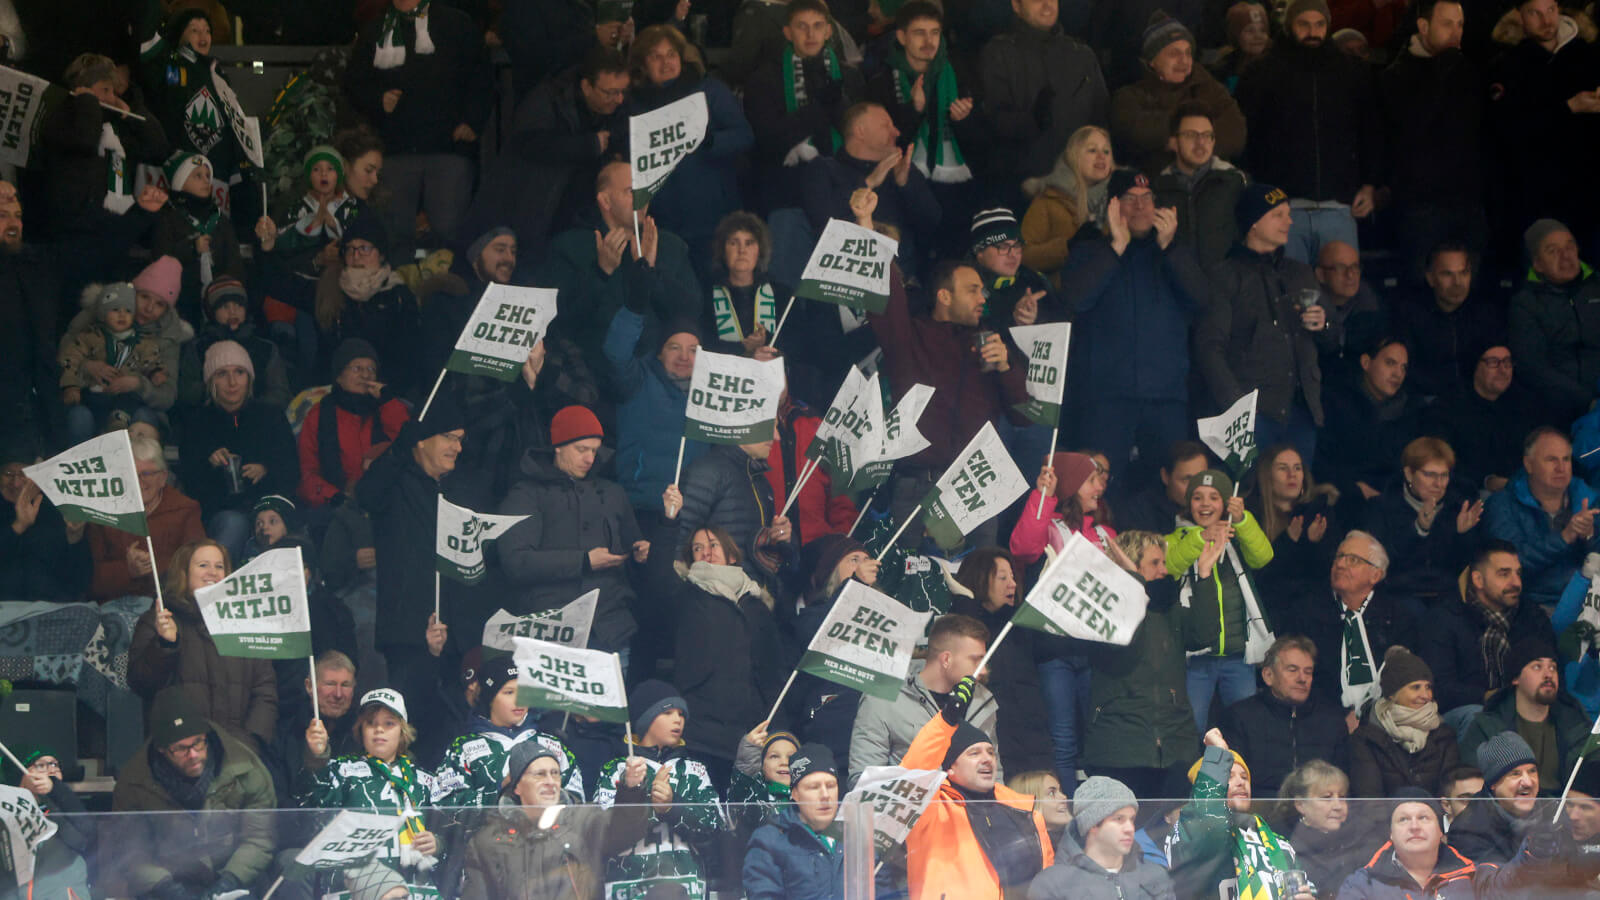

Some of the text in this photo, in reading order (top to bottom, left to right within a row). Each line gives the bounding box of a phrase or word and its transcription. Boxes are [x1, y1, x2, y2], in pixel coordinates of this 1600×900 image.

[649, 121, 686, 149] EHC
[840, 238, 878, 257] EHC
[819, 253, 885, 279] OLTEN
[494, 303, 536, 325] EHC
[473, 322, 539, 348] OLTEN
[708, 372, 755, 394] EHC
[691, 388, 767, 413] OLTEN
[967, 449, 996, 488] EHC
[951, 468, 986, 513] TEN
[1076, 571, 1119, 611] EHC
[851, 606, 897, 633] EHC
[1052, 583, 1117, 640] OLTEN
[828, 622, 899, 657] OLTEN
[368, 692, 395, 702] OLTEN
[347, 828, 393, 839] EHC
